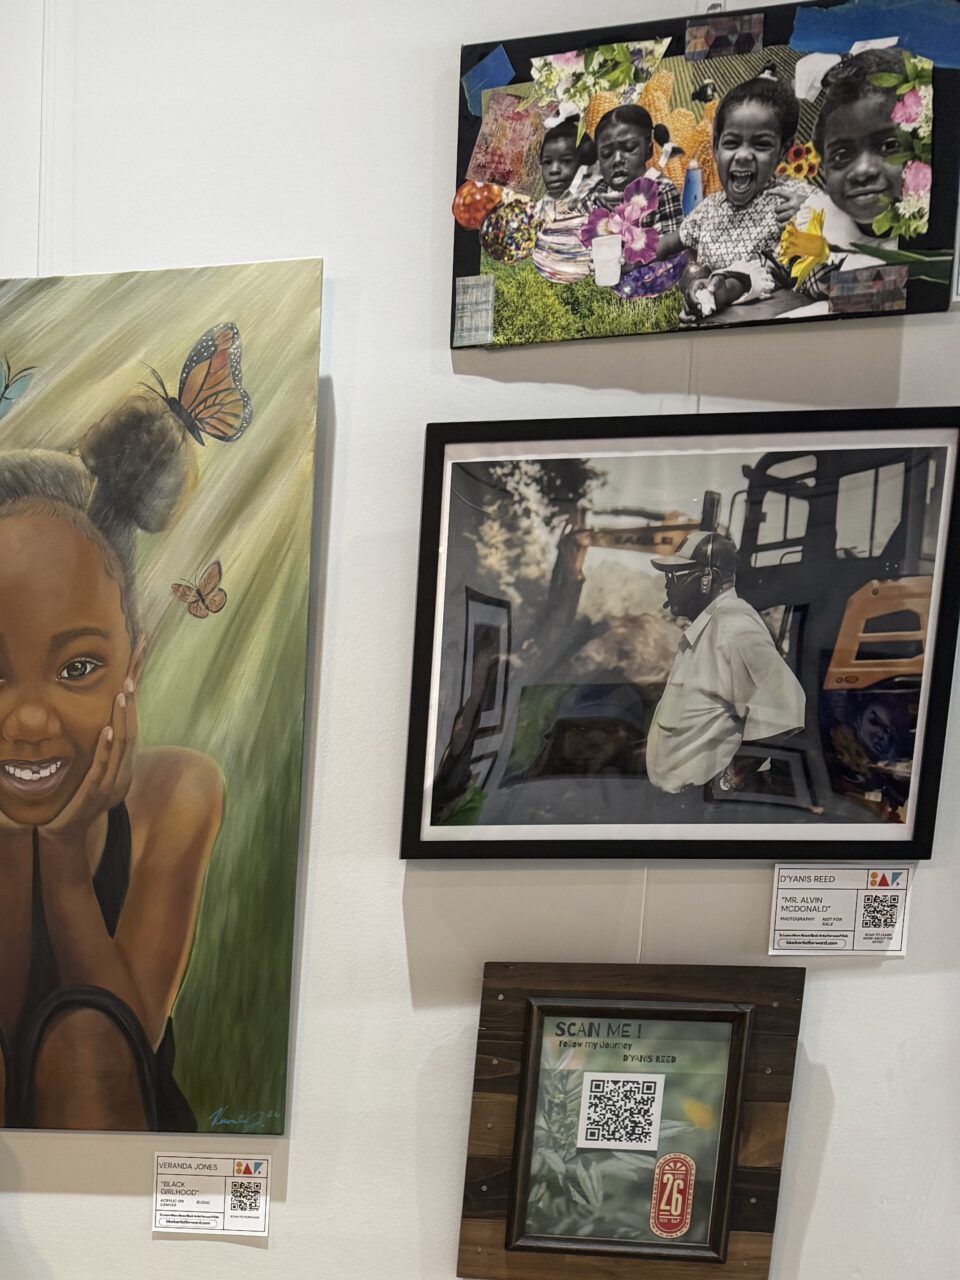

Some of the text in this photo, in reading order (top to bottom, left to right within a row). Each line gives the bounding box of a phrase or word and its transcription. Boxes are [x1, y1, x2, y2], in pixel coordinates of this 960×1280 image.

[780, 875, 836, 883] D'YANIS REED
[555, 1021, 601, 1038] SCAN
[607, 1022, 632, 1038] ME
[585, 1042, 597, 1050] my
[655, 1055, 676, 1063] REED
[159, 1162, 192, 1170] VERANDA
[660, 1174, 684, 1216] 26
